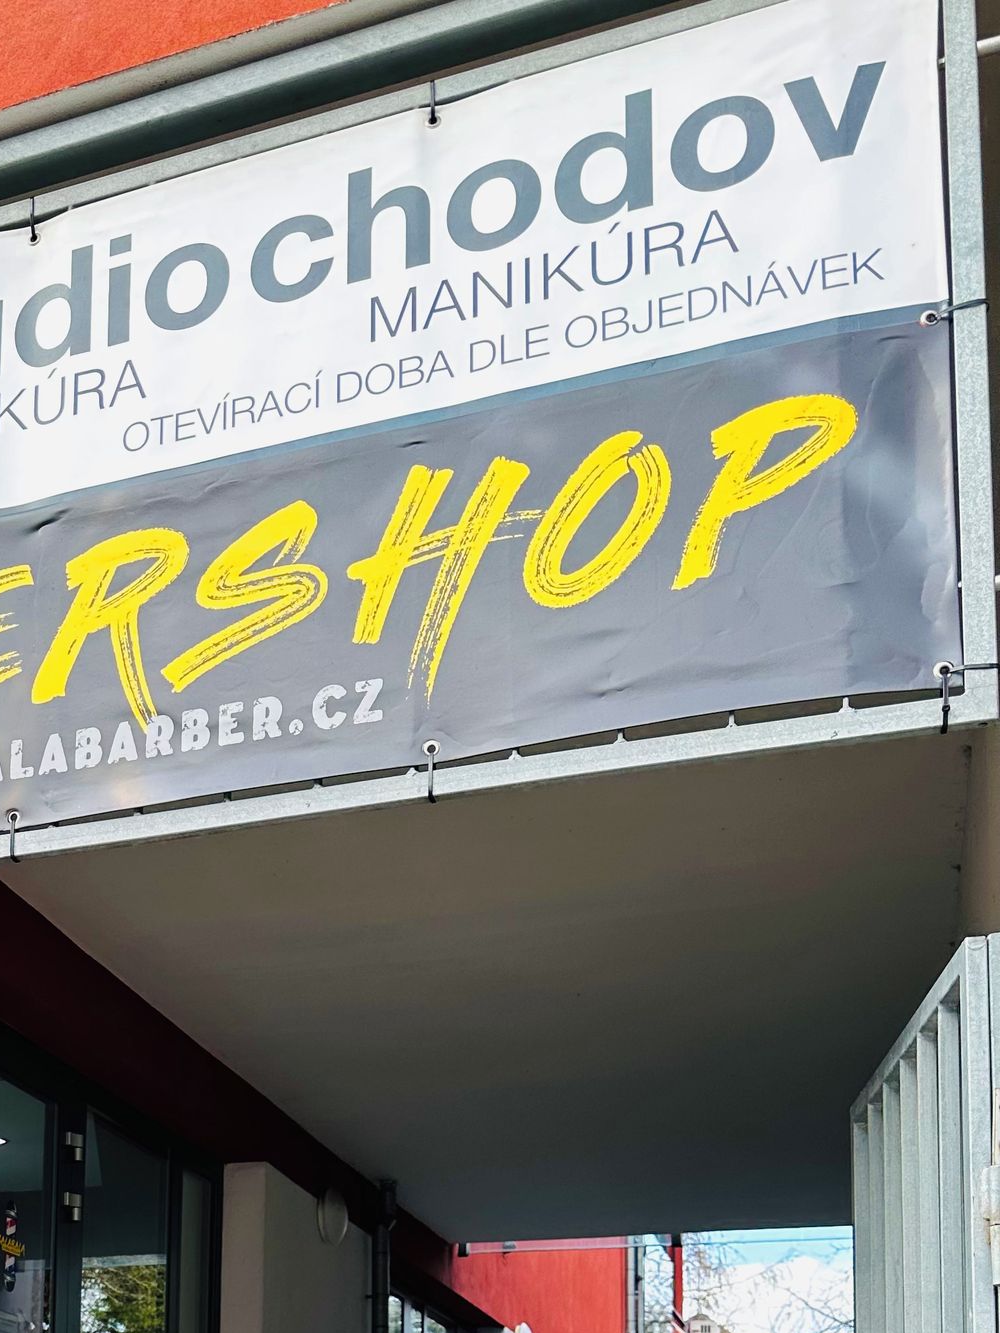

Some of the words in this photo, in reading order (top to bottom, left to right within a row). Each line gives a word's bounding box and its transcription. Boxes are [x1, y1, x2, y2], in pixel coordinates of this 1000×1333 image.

[122, 371, 323, 453] OTEVÍRACÍ
[335, 352, 454, 404] DOBA
[469, 326, 550, 371] DLE
[564, 249, 885, 350] OBJEDNÁVEK
[370, 210, 738, 342] MANIKÚRA
